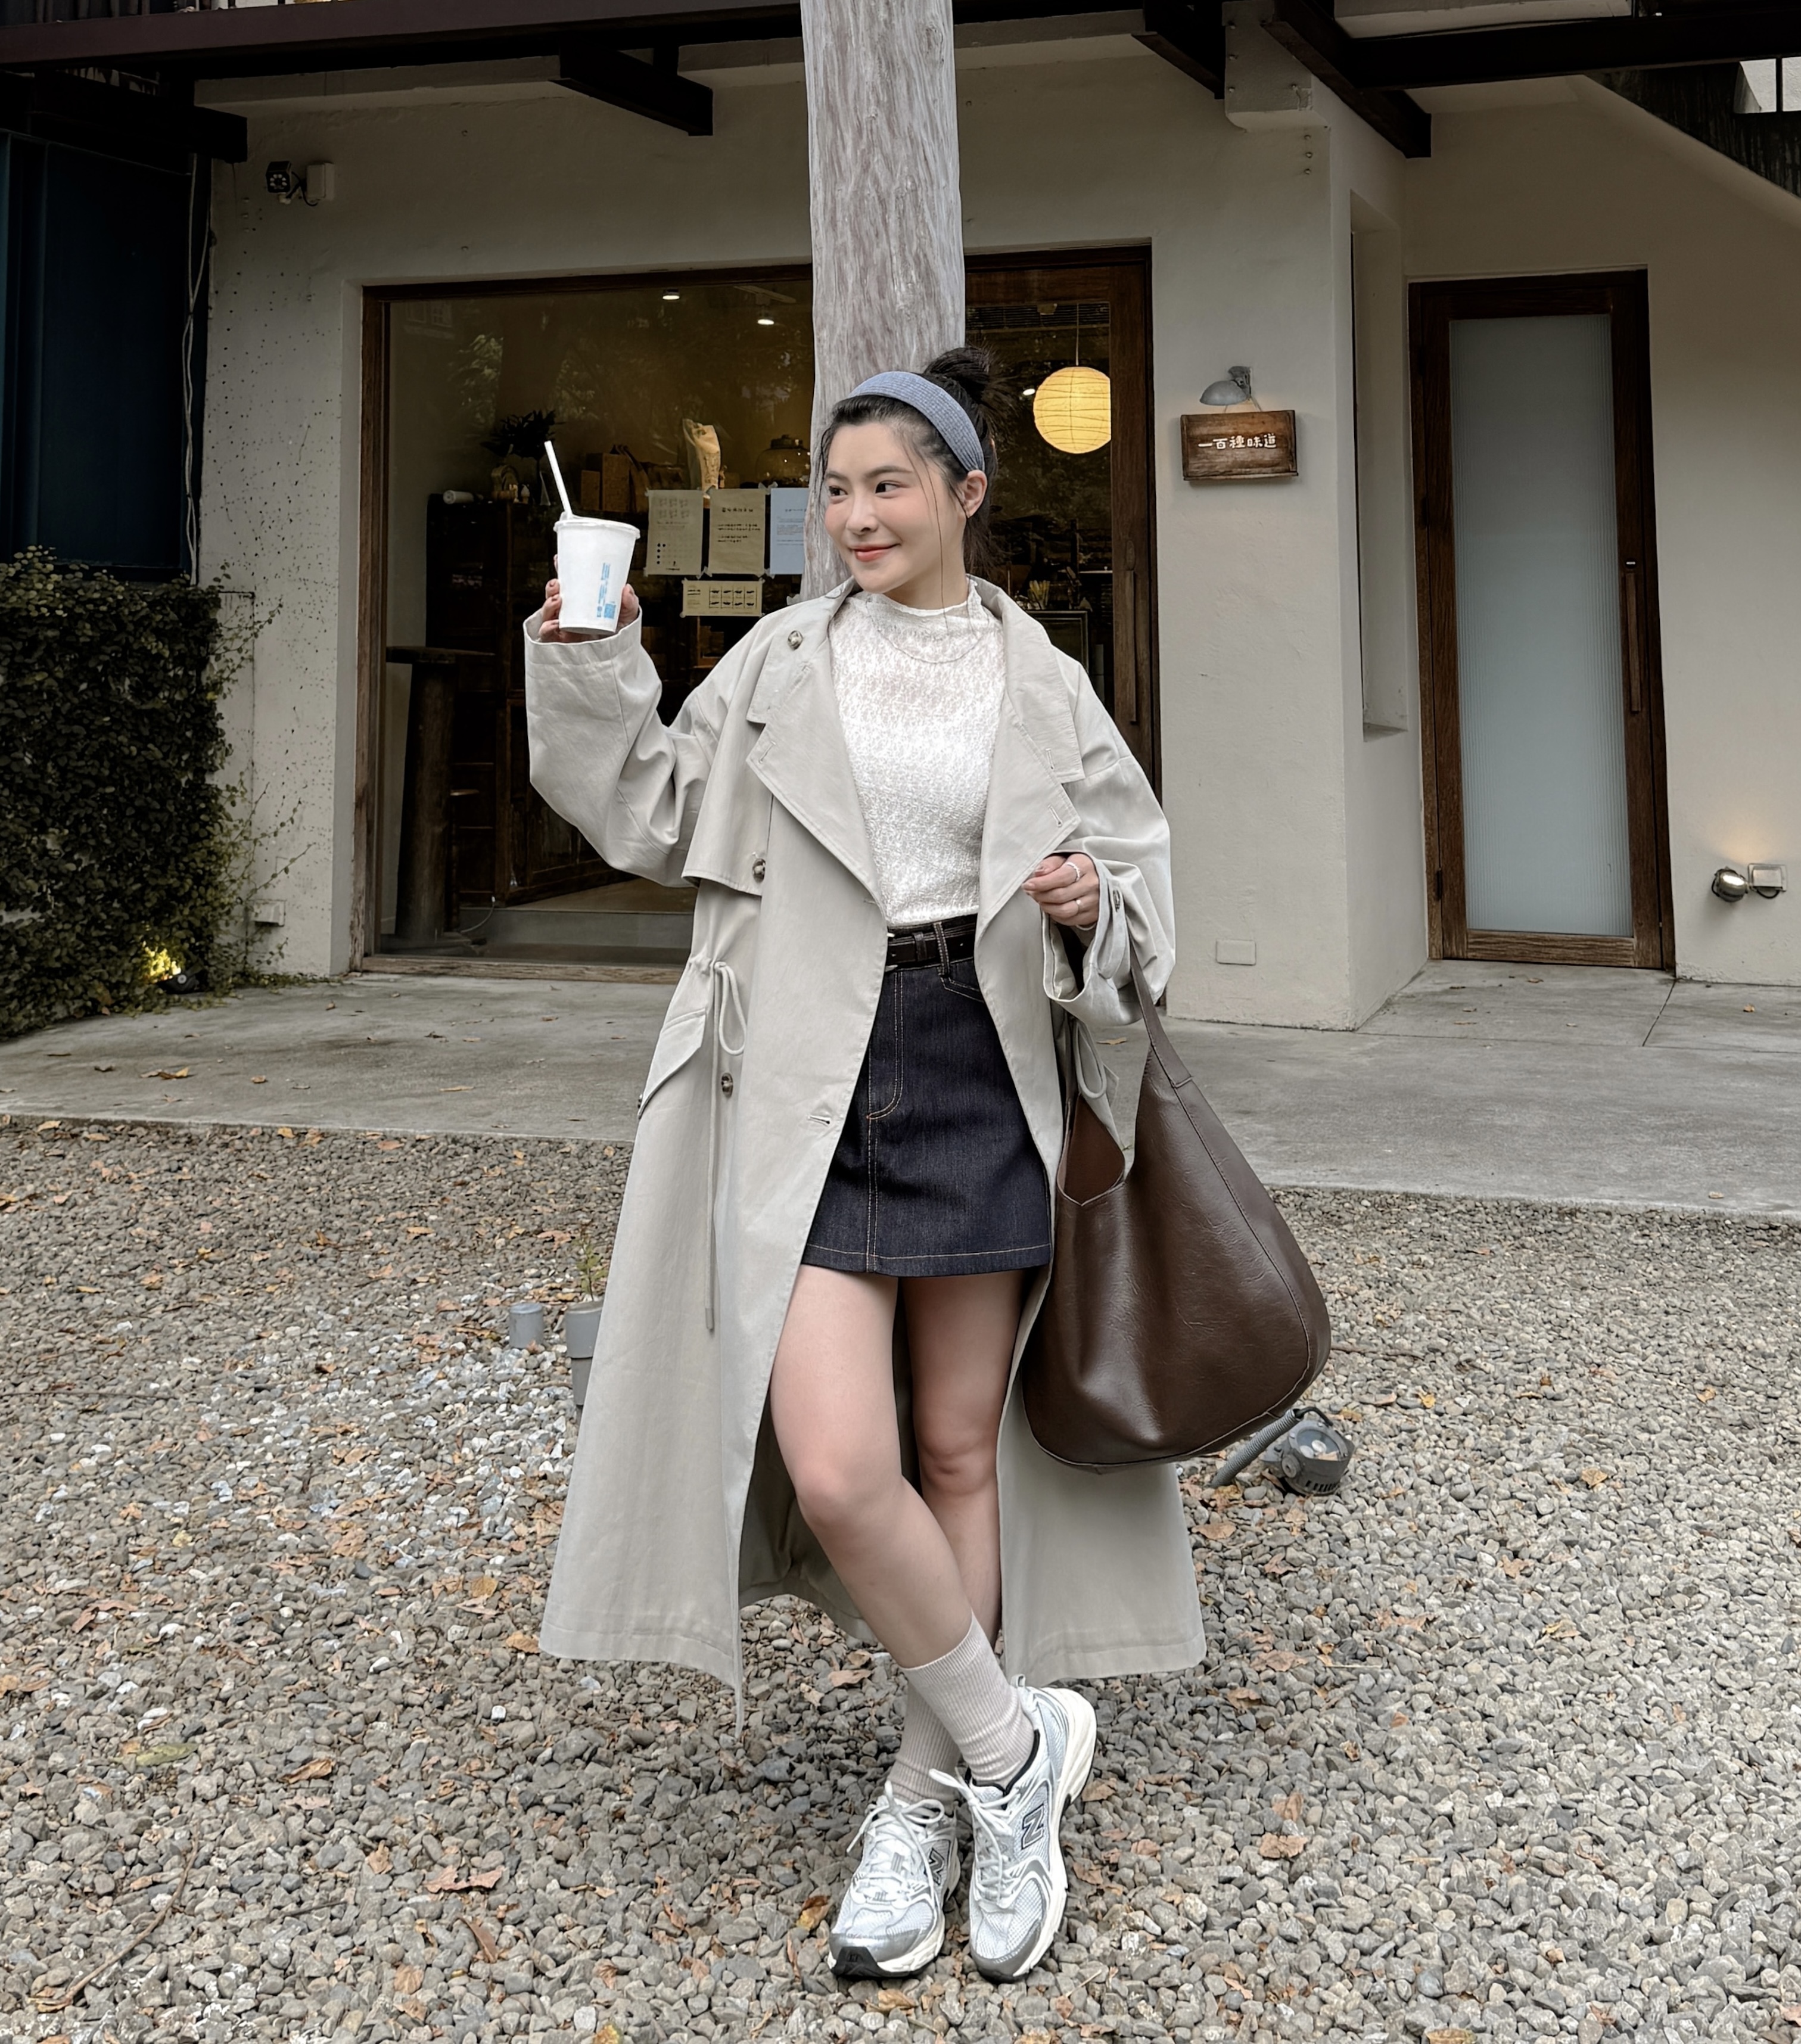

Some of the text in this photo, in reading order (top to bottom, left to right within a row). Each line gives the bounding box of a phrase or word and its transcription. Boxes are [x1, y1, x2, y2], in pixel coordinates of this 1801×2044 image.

[1198, 433, 1277, 450] 一百種味道
